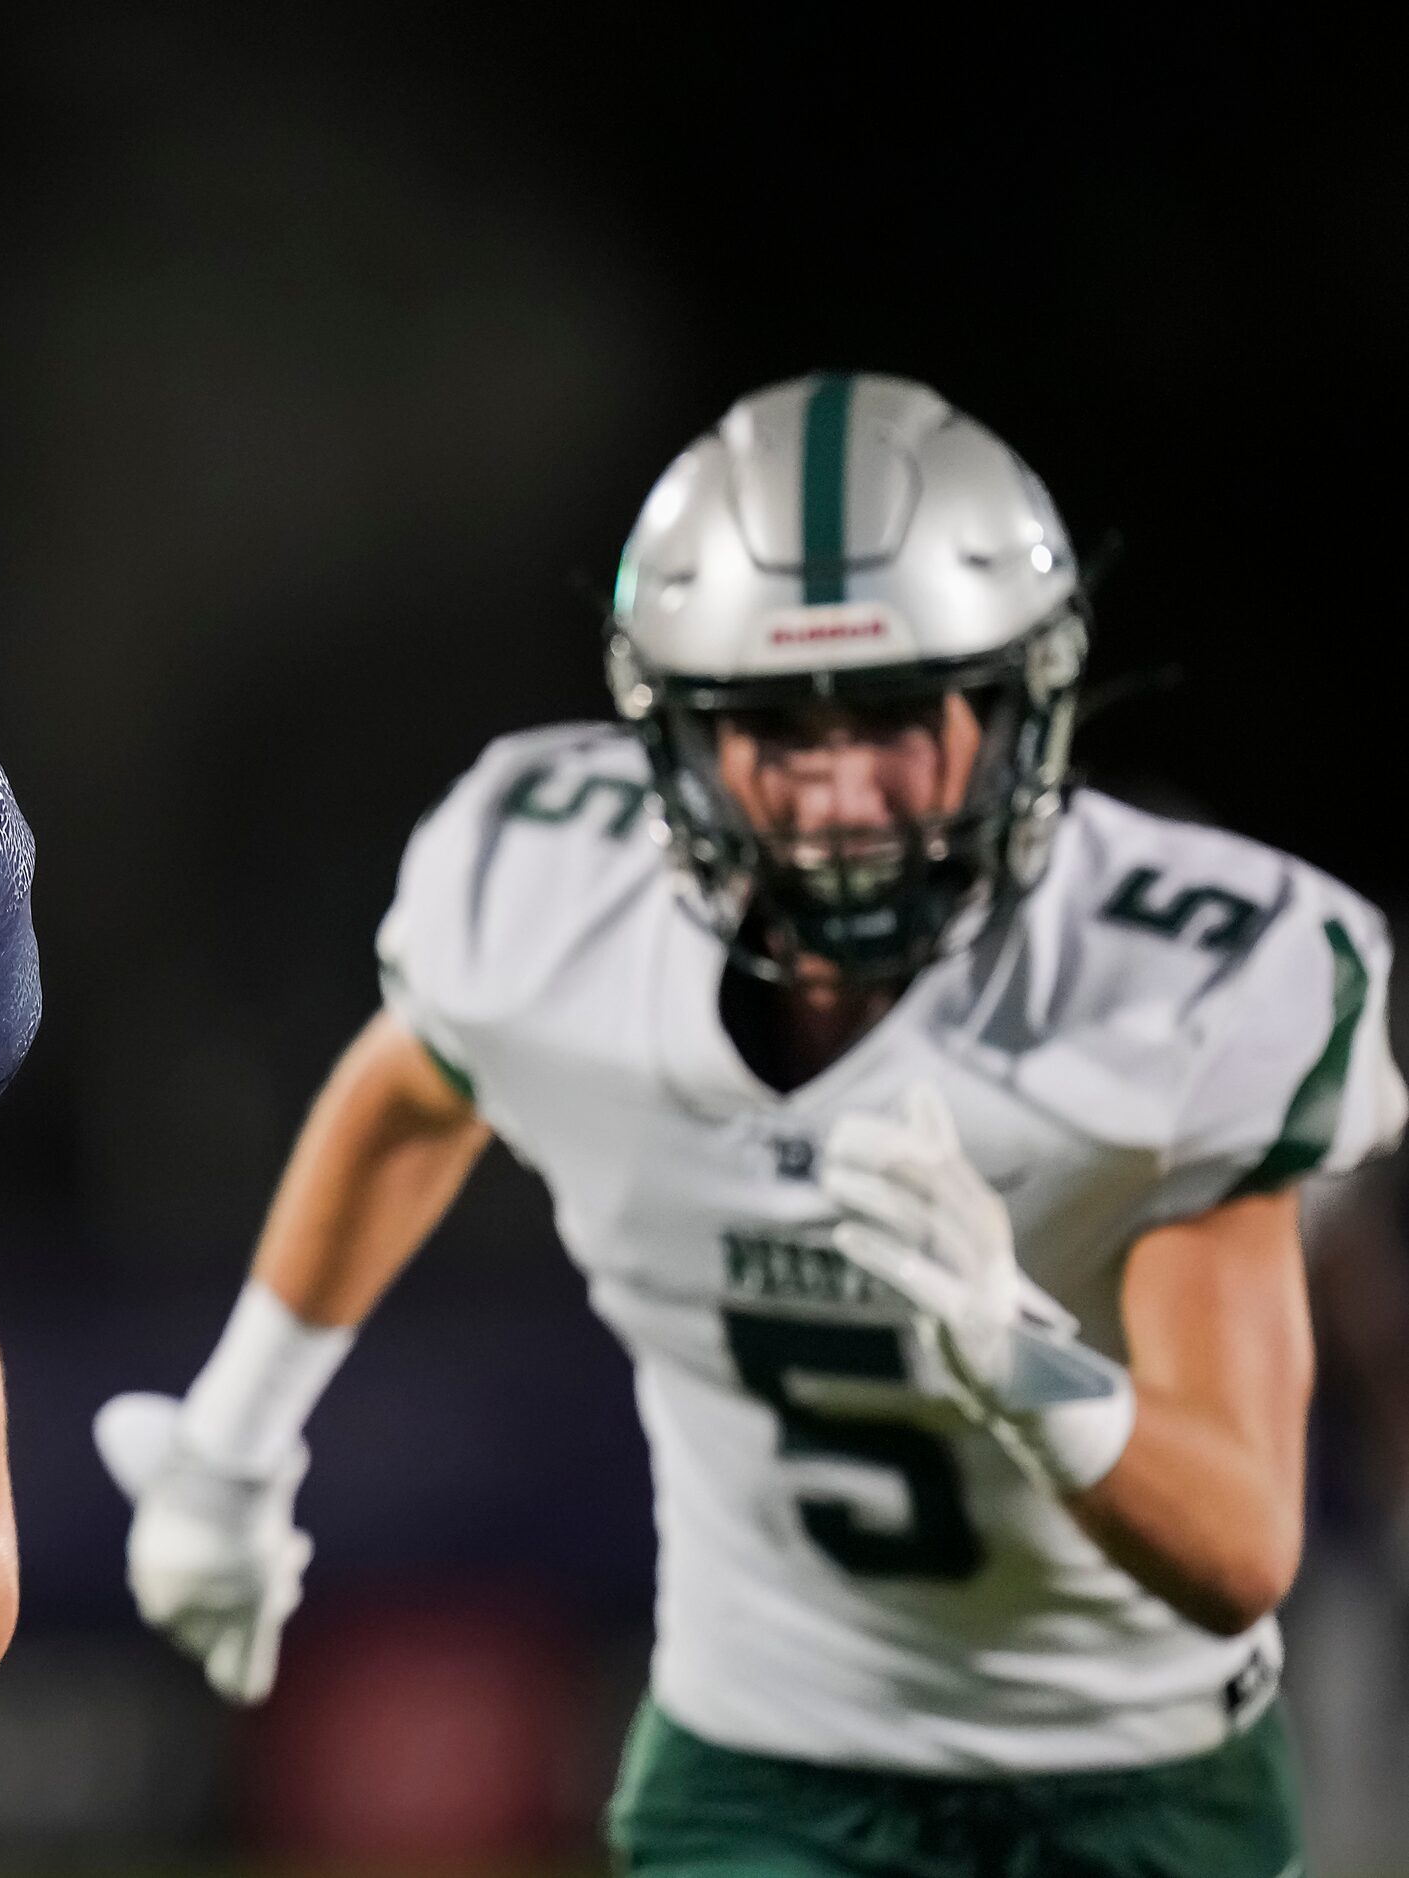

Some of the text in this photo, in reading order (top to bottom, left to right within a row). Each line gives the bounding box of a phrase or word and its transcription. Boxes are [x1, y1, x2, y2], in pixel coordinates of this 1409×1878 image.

[502, 764, 646, 841] 5
[1098, 868, 1262, 951] 5
[722, 1305, 984, 1582] 5
